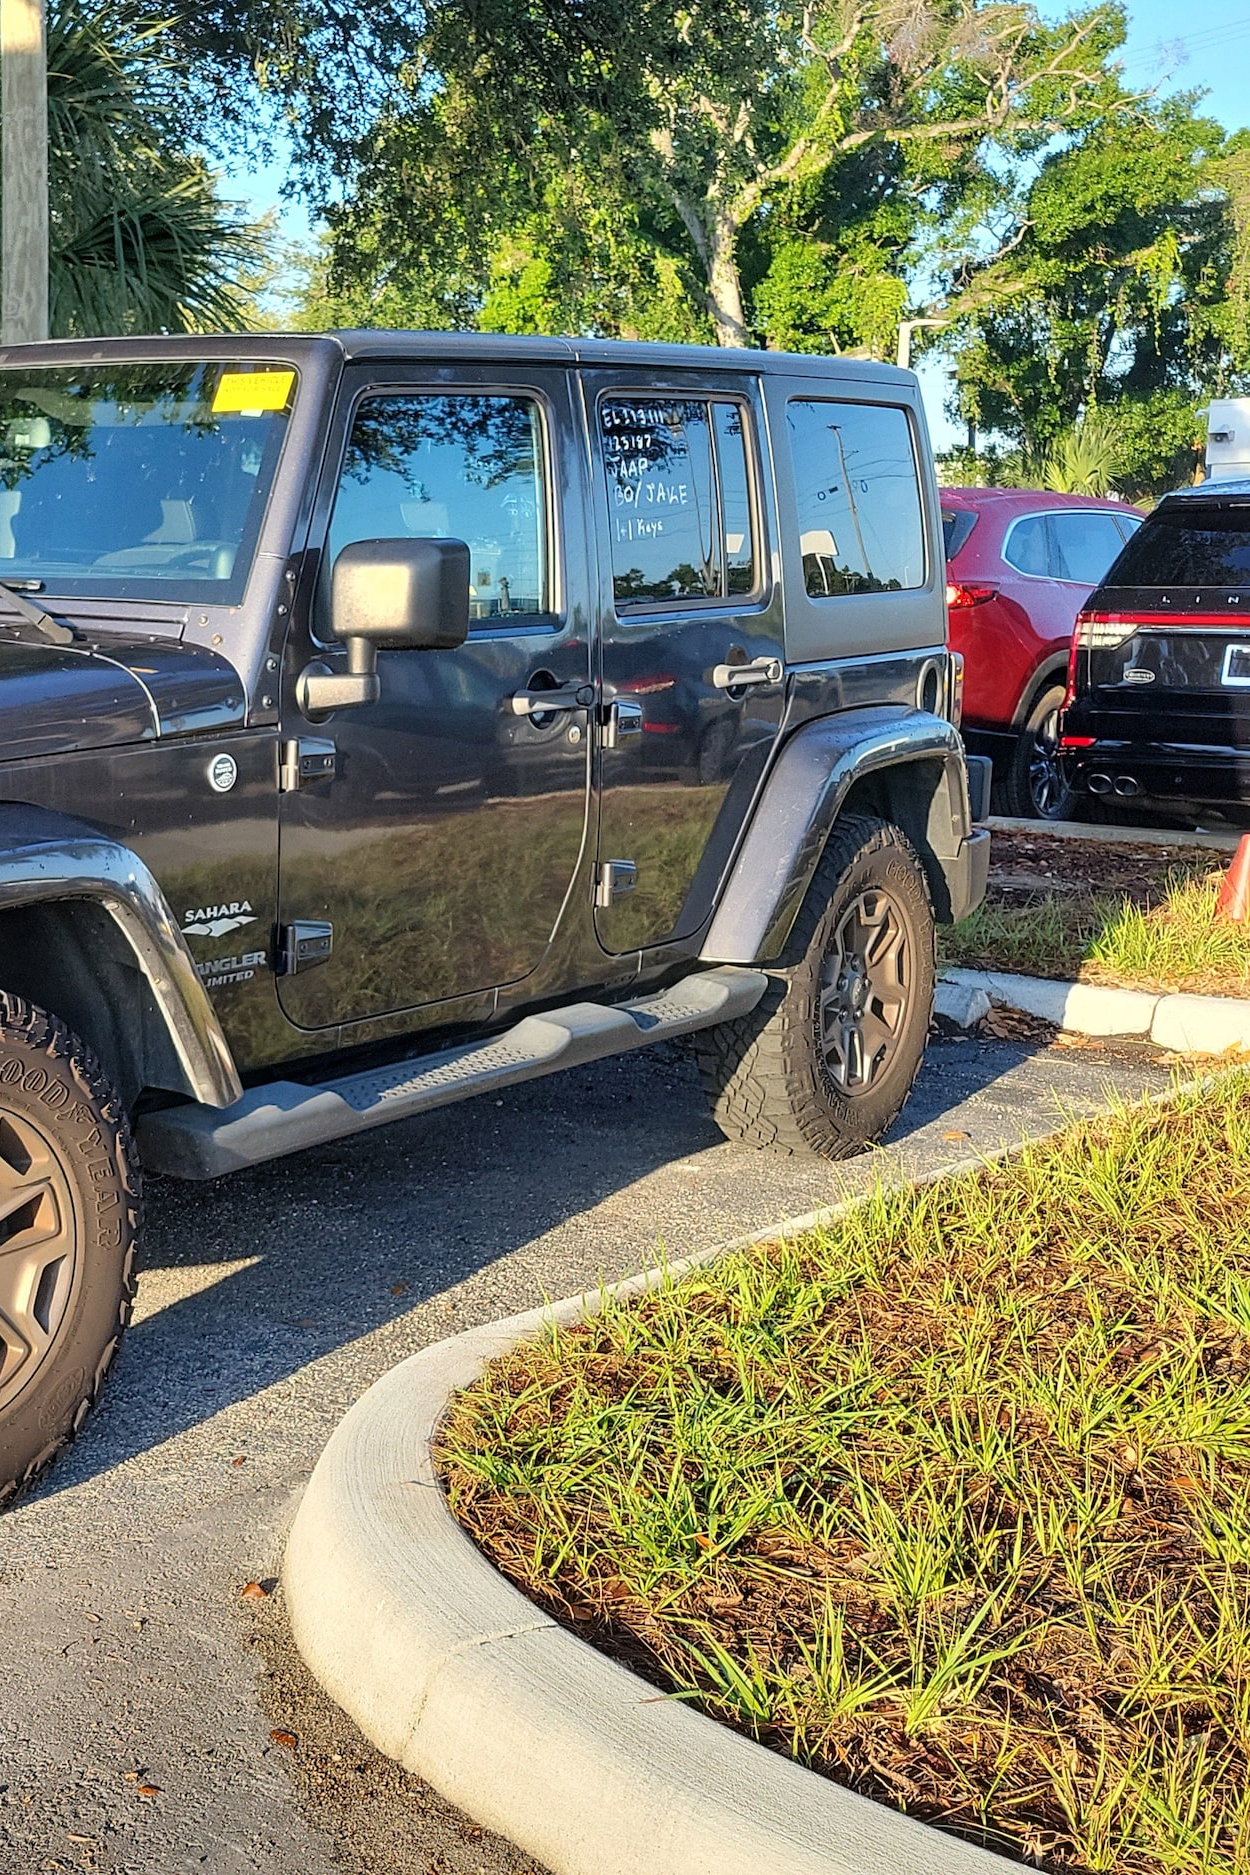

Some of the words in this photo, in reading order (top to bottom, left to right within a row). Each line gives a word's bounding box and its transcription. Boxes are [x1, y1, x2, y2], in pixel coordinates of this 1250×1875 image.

[185, 901, 252, 922] SAHARA
[196, 951, 266, 975] ANGLER
[206, 970, 254, 987] IMITED
